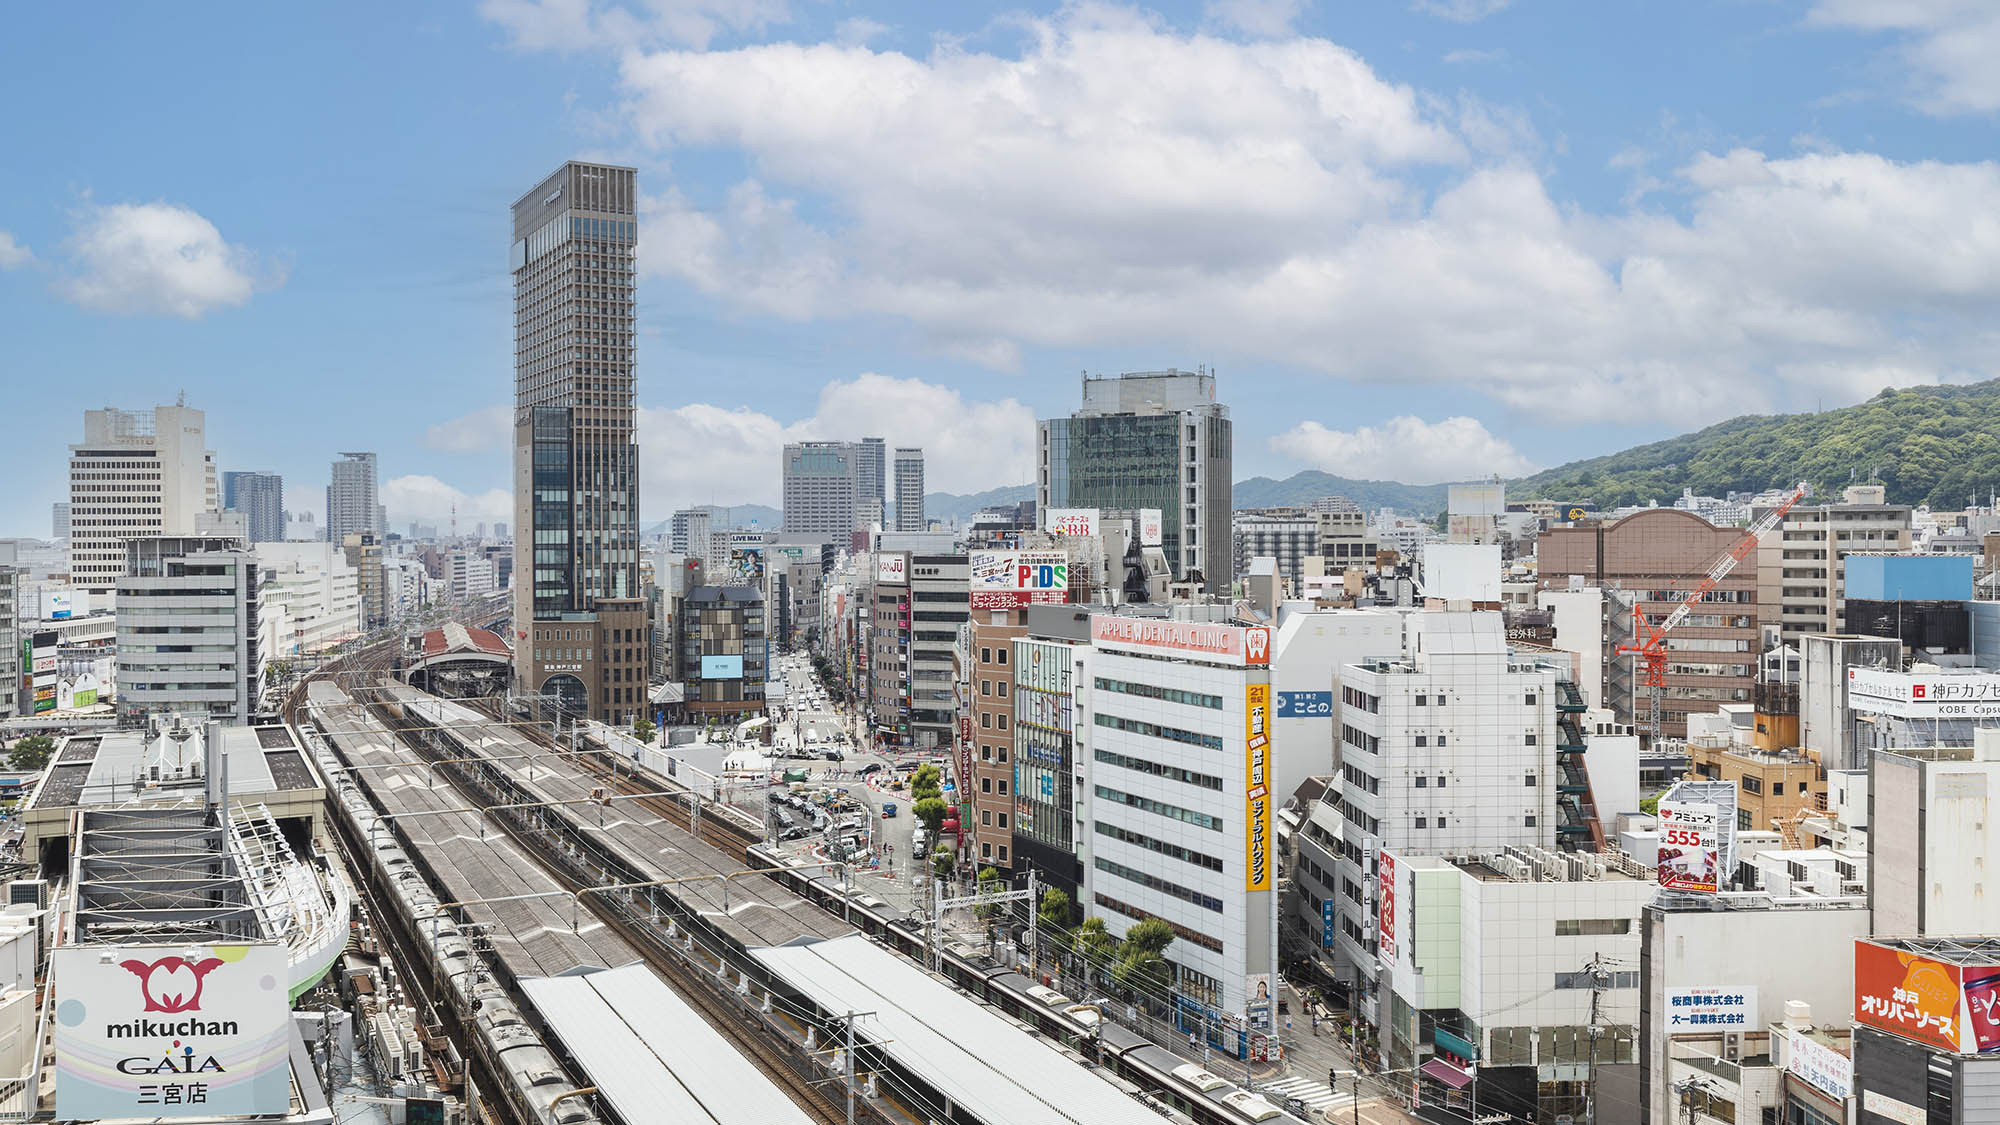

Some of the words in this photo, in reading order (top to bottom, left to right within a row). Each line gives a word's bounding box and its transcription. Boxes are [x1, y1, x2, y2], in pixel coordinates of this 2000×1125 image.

[1100, 621, 1132, 640] APPLE
[1143, 625, 1186, 646] DENTAL
[1188, 630, 1229, 650] CLINIC
[1250, 633, 1264, 648] 歯
[1250, 687, 1264, 696] 21
[1294, 702, 1332, 713] ことの
[1674, 812, 1715, 824] アミューズ
[1252, 800, 1264, 885] セントラルハウジング
[1671, 994, 1744, 1006] 桜商事株式会社
[1892, 986, 1919, 1004] 神戸
[1861, 994, 1954, 1038] オリバーソース
[107, 1018, 238, 1038] mikuchan
[137, 1083, 208, 1105] 三宮店
